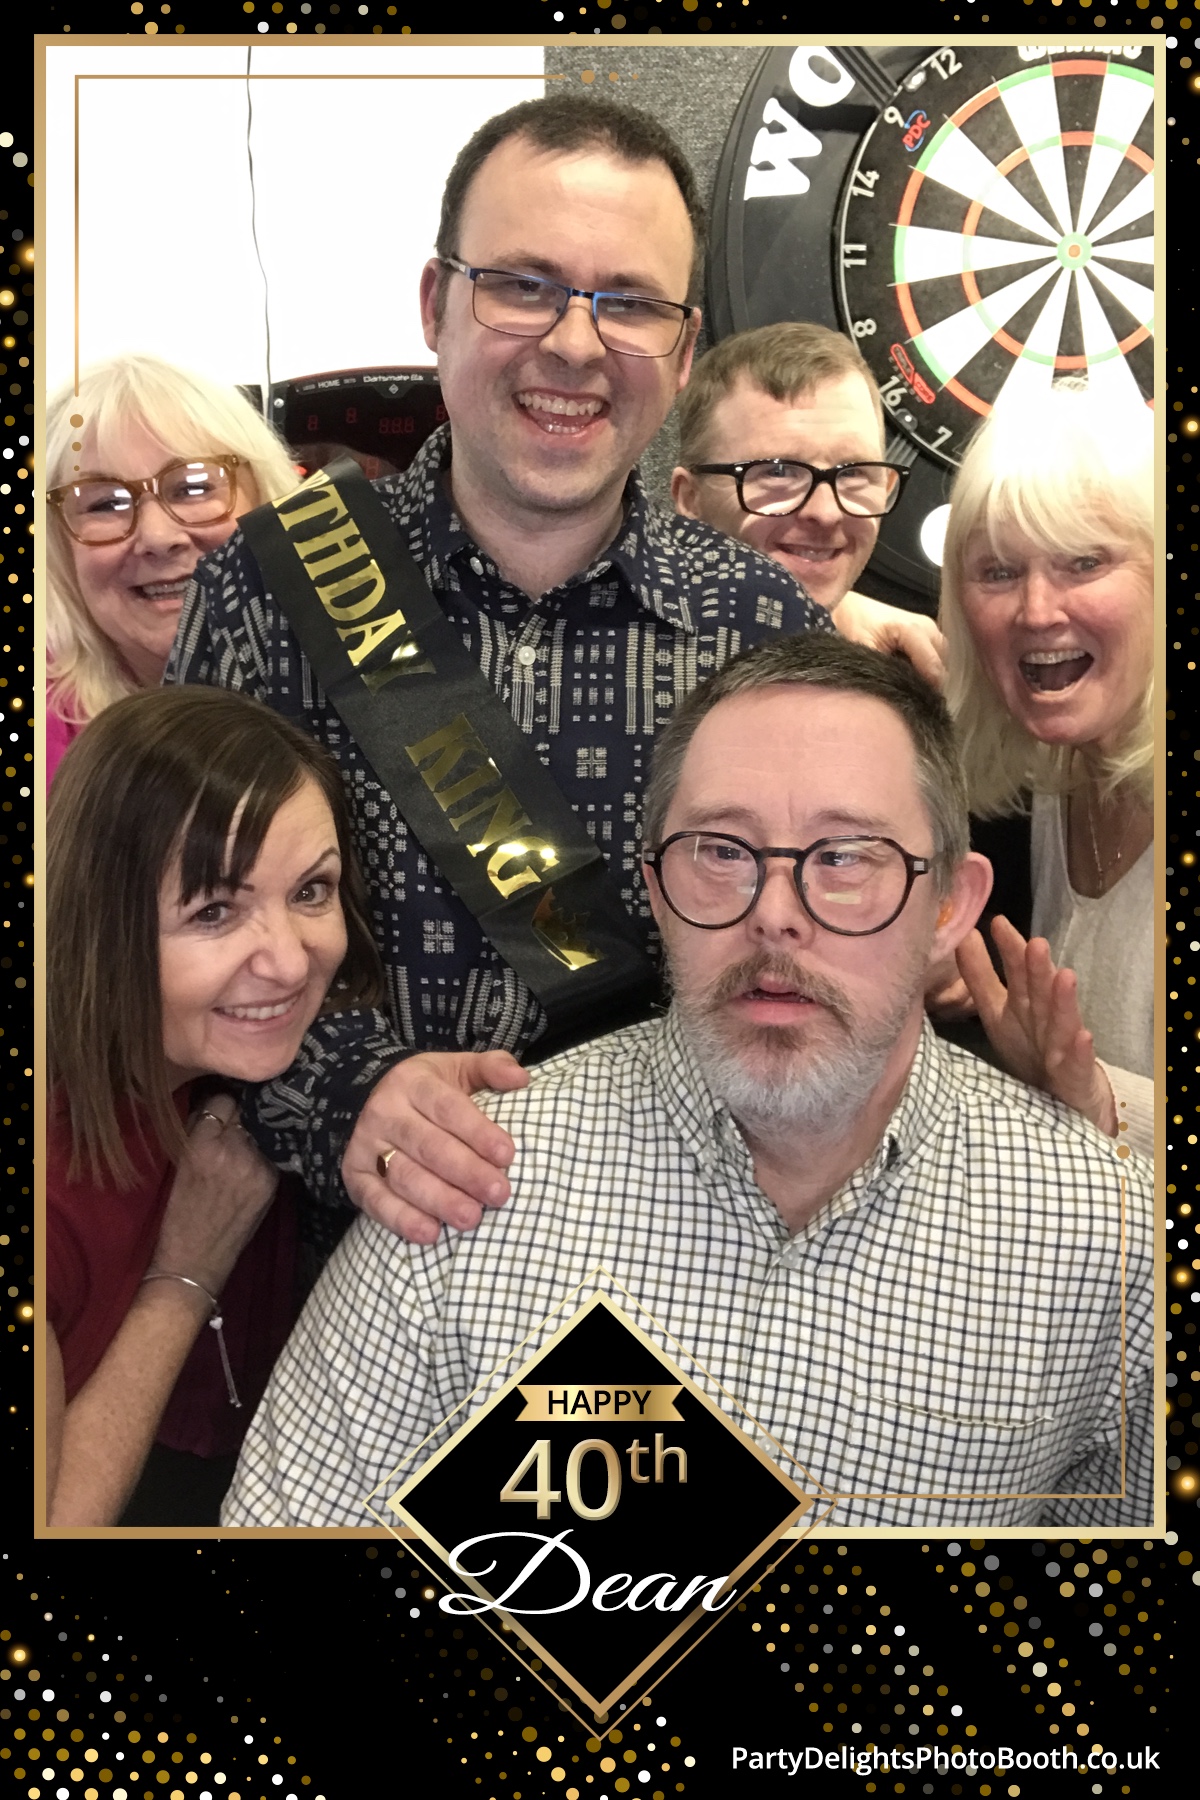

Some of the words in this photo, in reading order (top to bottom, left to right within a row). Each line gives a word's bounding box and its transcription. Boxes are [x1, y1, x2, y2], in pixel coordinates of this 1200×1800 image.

[930, 49, 963, 80] 12
[884, 106, 905, 128] 9
[902, 114, 931, 148] PDC
[852, 170, 880, 198] 14
[843, 243, 867, 269] 11
[853, 318, 877, 338] 8
[317, 379, 341, 389] HOME
[879, 375, 908, 407] 16
[931, 425, 953, 450] 7
[405, 712, 560, 899] KING
